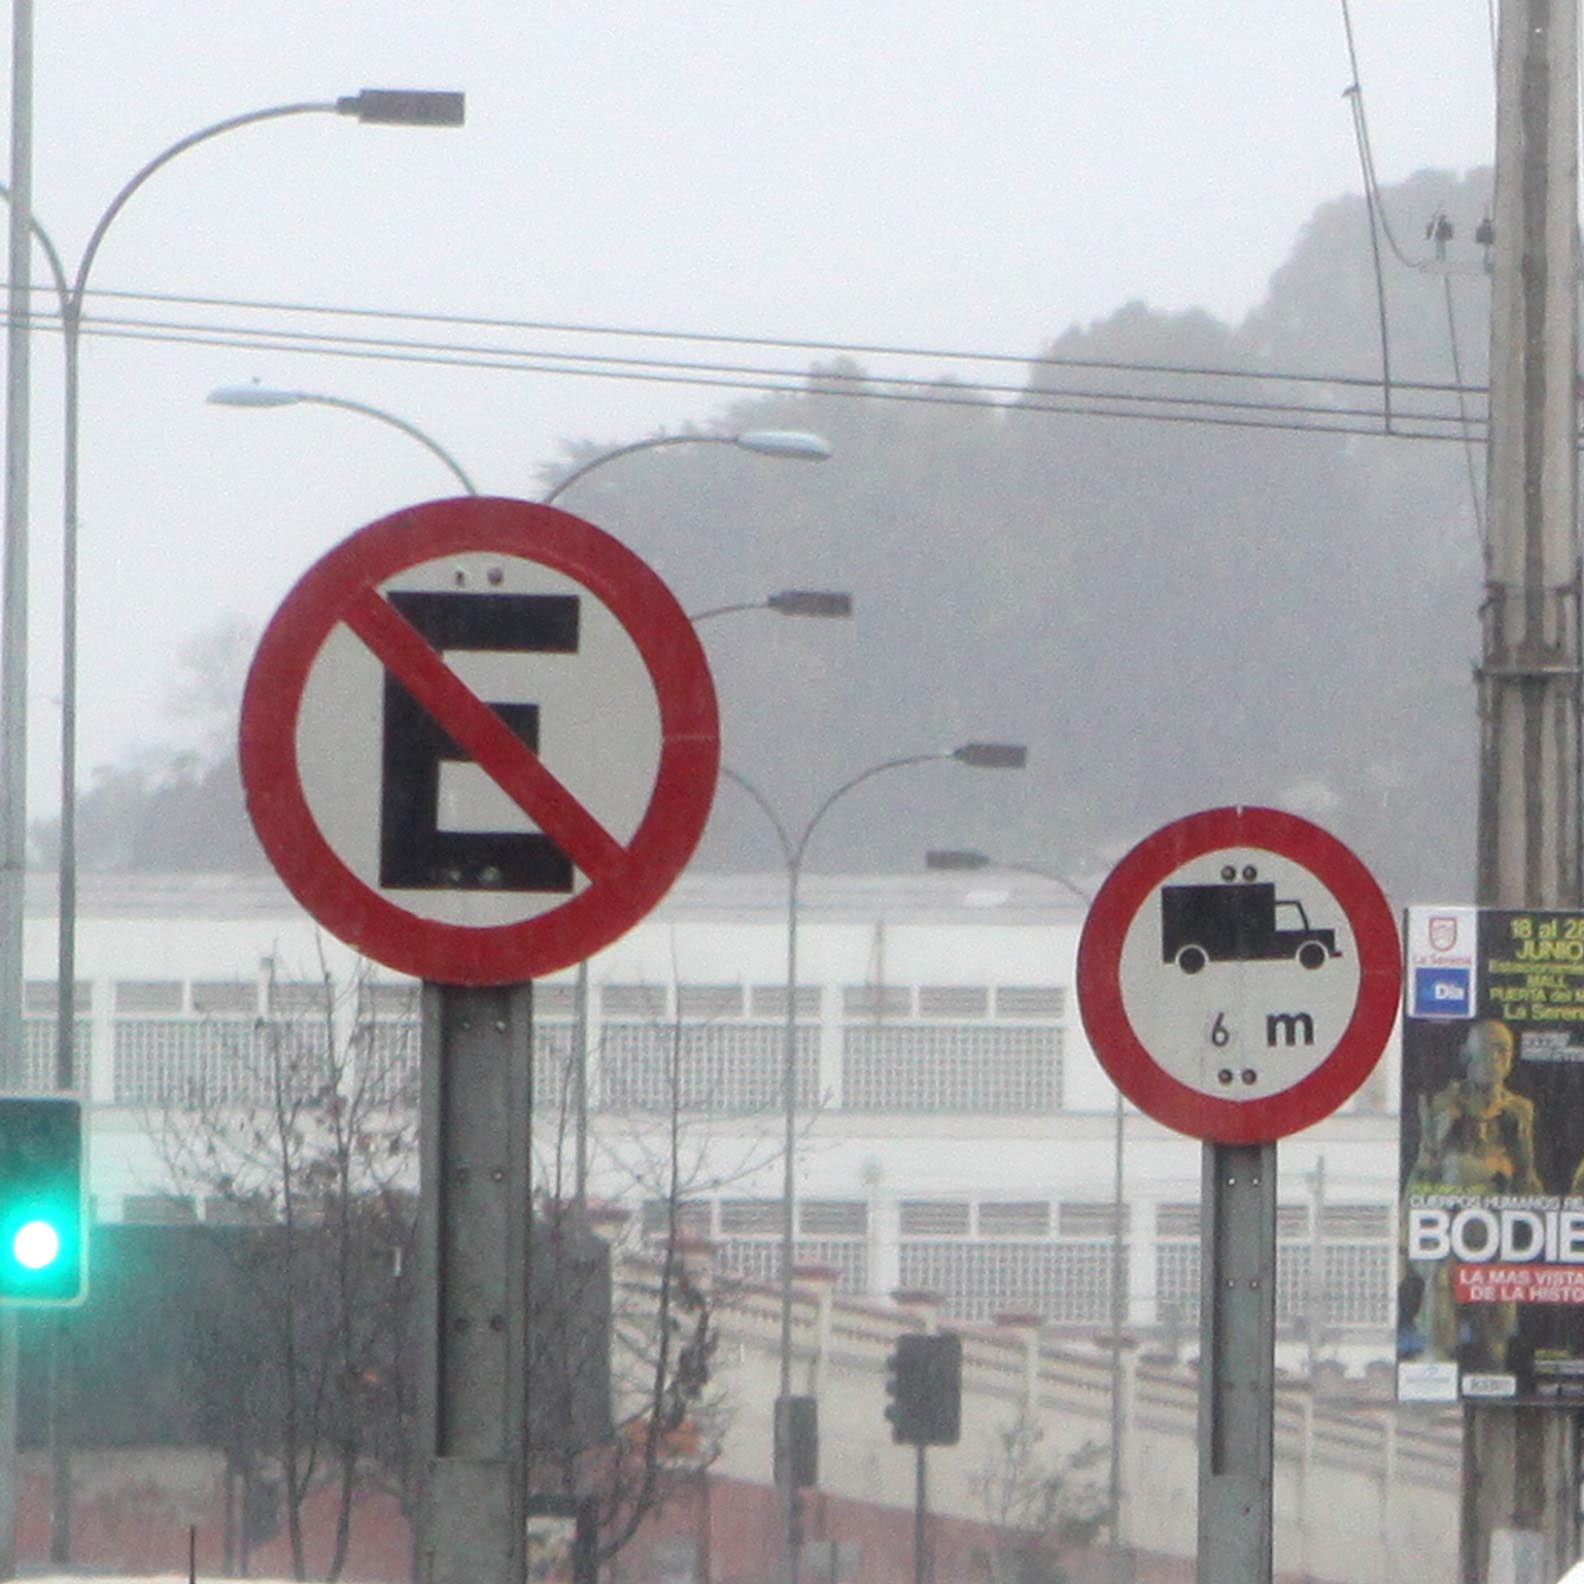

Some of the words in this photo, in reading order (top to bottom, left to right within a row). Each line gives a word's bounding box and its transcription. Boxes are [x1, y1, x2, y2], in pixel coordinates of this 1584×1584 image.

[380, 591, 580, 892] E
[1512, 919, 1531, 939] 18
[1540, 919, 1557, 938] al
[1516, 940, 1584, 960] JUNIO
[1504, 1004, 1526, 1019] La
[1210, 1012, 1230, 1047] 6
[1266, 1011, 1314, 1047] m
[1460, 1270, 1483, 1285] LA
[1470, 1286, 1495, 1300] DE
[1501, 1286, 1525, 1301] LA
